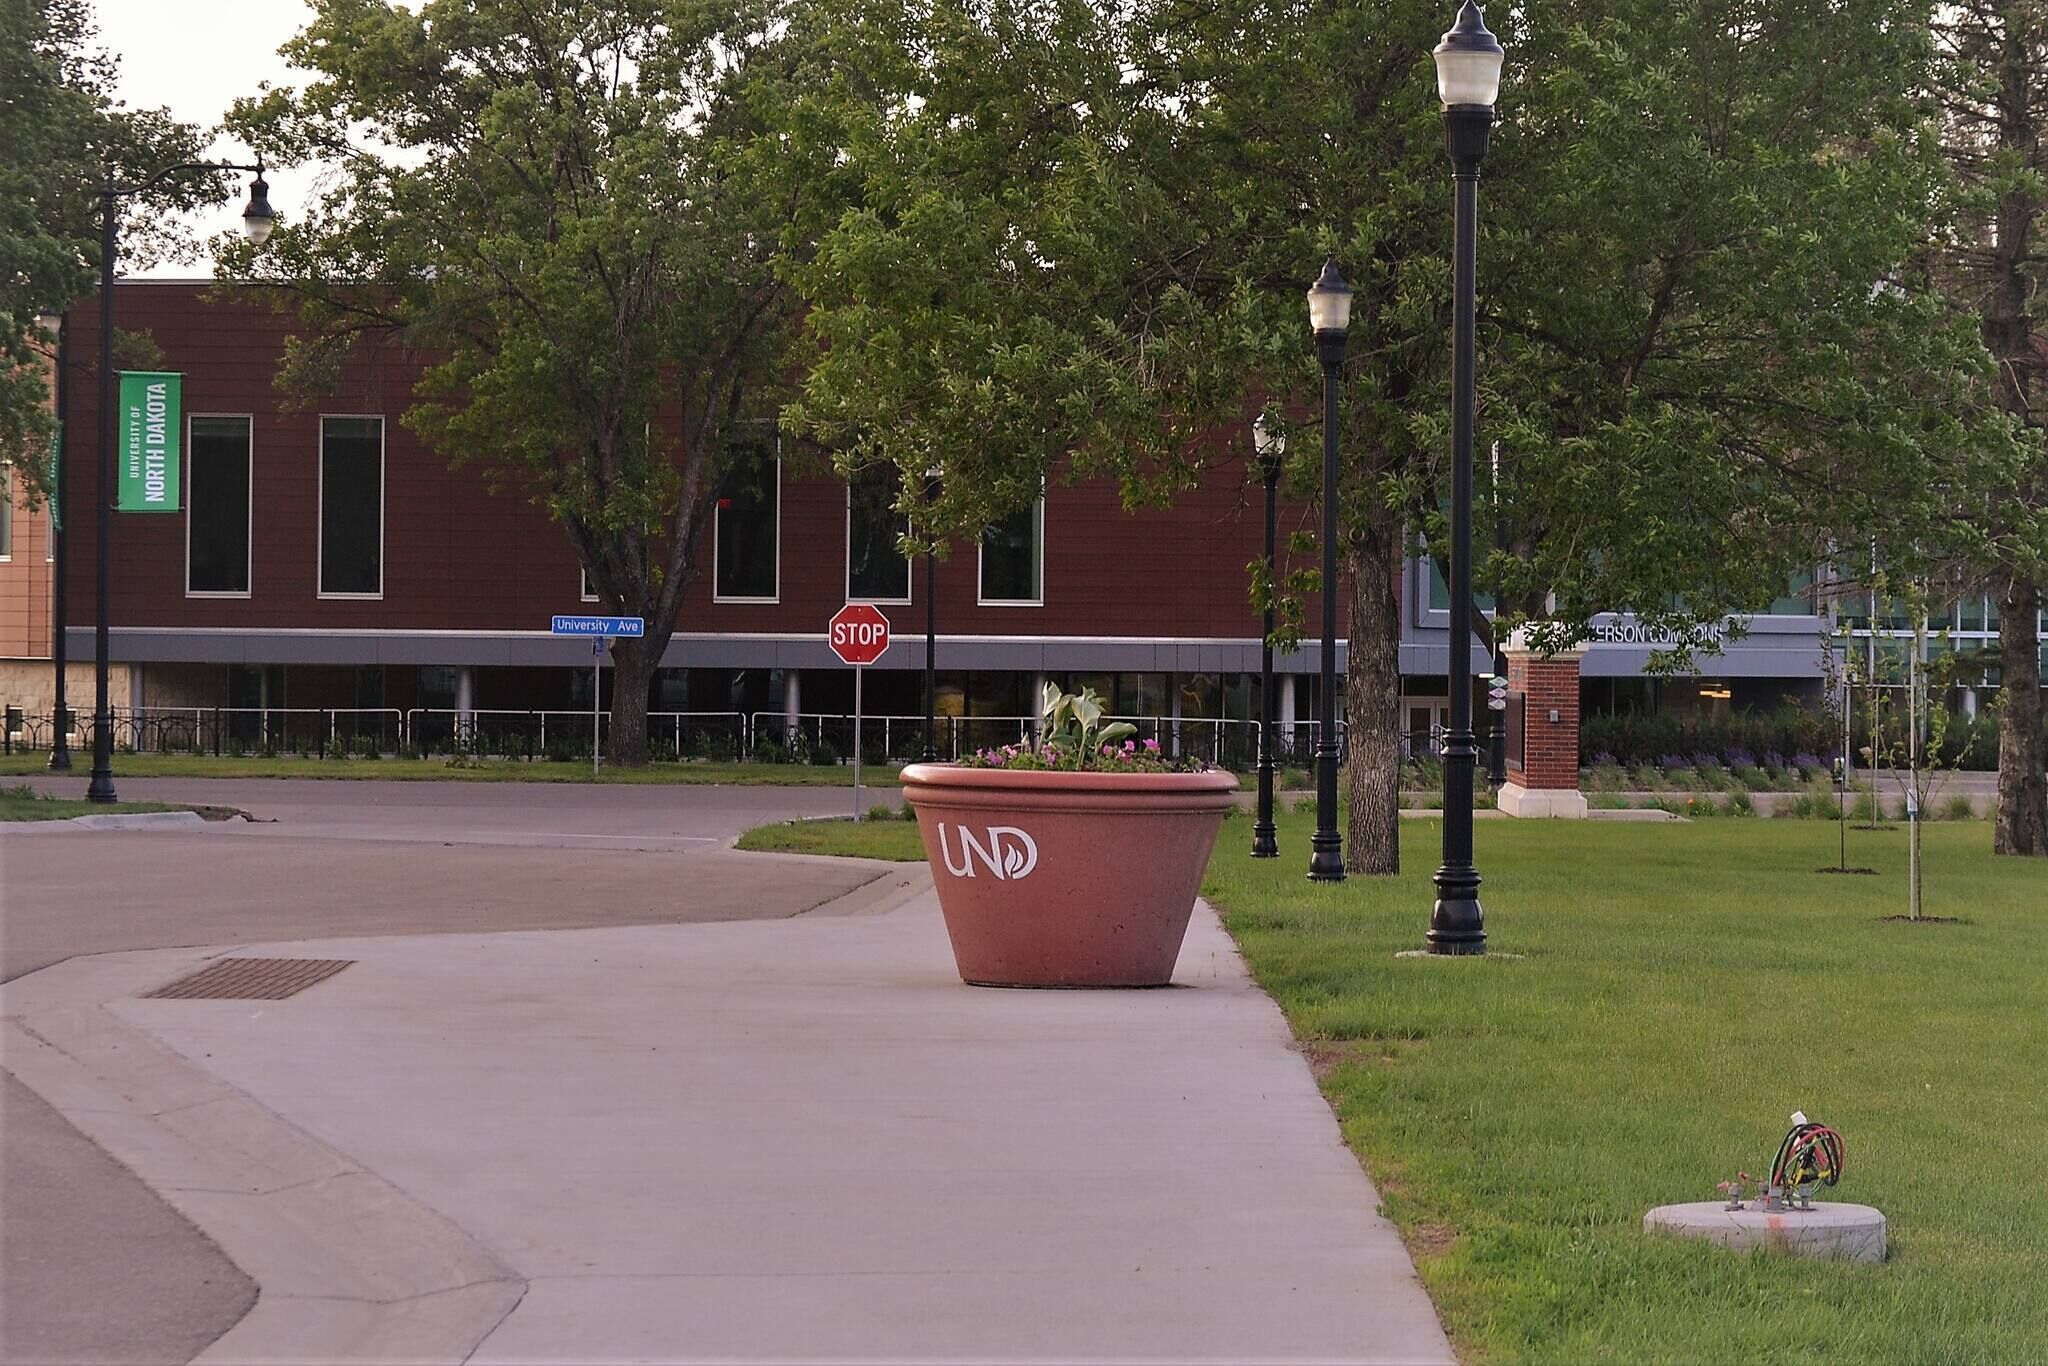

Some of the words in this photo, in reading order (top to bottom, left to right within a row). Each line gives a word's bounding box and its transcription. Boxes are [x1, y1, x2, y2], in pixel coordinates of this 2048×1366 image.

[130, 405, 141, 418] OF
[146, 383, 167, 445] DAKOTA
[129, 420, 141, 479] UNIVERSITY
[145, 448, 165, 502] NORTH
[557, 618, 610, 632] University
[617, 620, 639, 632] Ave
[833, 622, 886, 646] STOP
[937, 822, 1038, 881] UND
